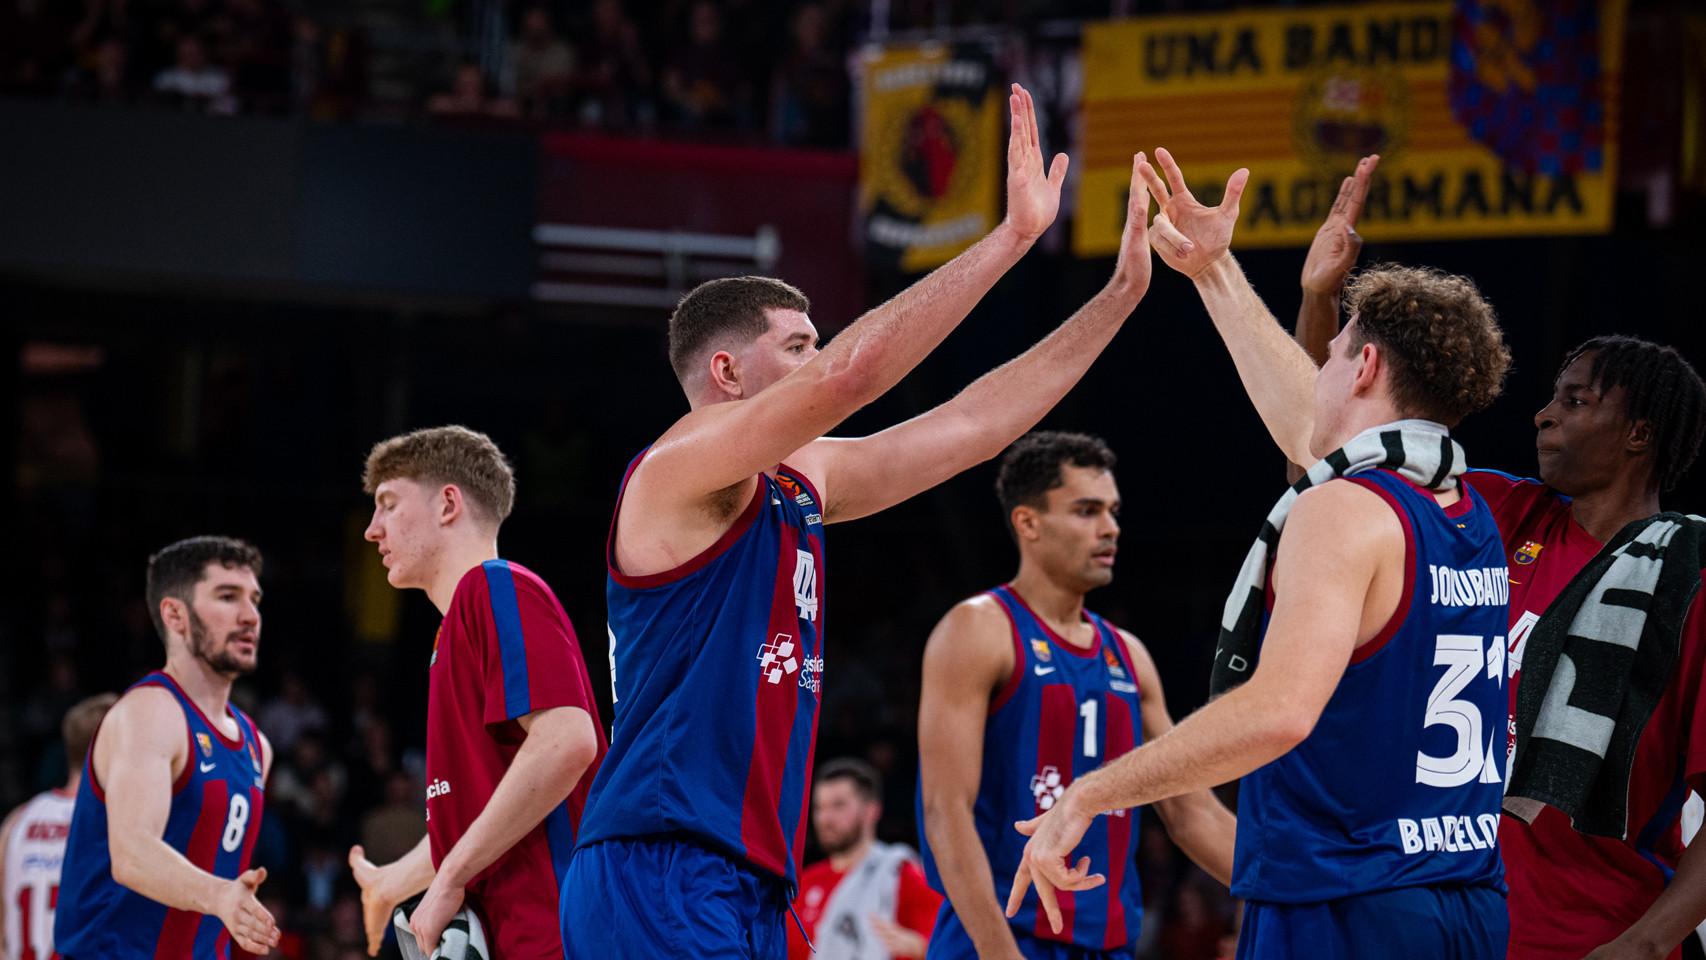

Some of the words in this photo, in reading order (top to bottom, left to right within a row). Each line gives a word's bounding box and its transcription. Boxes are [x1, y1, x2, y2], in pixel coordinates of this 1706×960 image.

[1144, 27, 1262, 79] UNA
[1284, 15, 1449, 69] BAND
[1080, 699, 1098, 757] 1
[221, 792, 249, 853] 8
